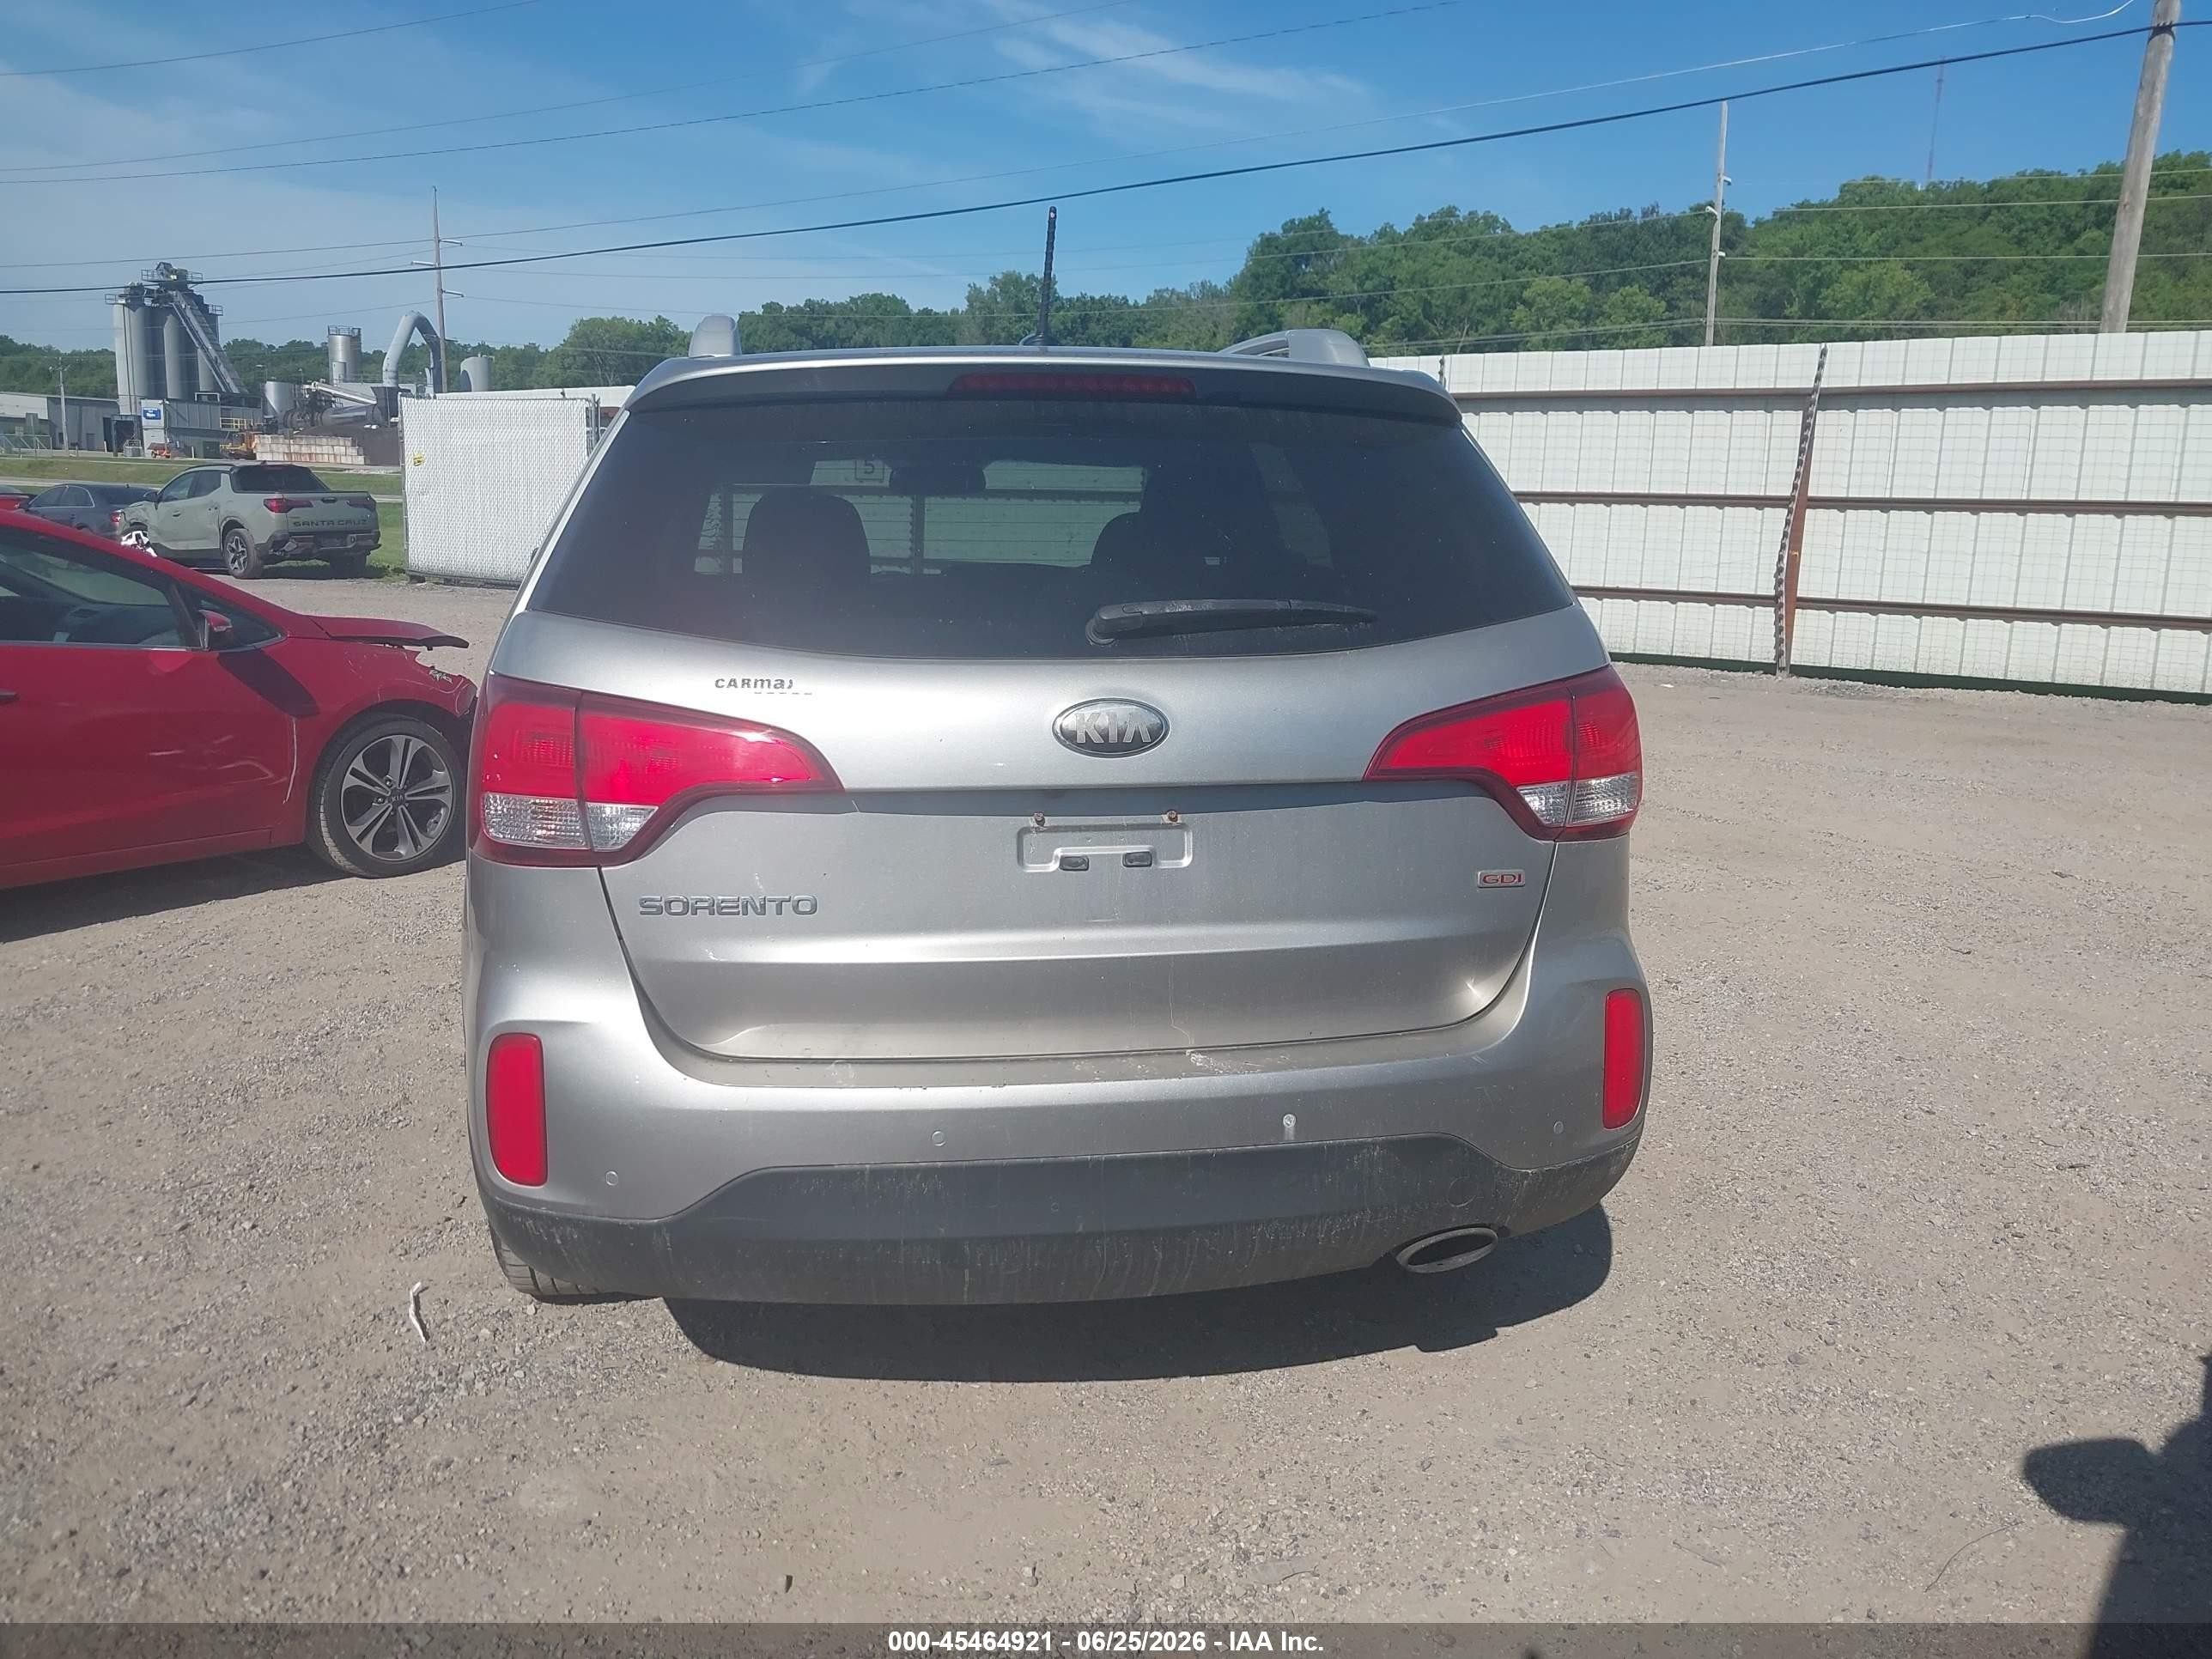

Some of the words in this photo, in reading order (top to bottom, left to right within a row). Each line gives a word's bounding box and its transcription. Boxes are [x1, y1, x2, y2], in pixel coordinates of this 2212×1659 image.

[1075, 713, 1152, 744] KIA
[1483, 873, 1522, 884] GDI
[638, 895, 818, 916] SORENTO
